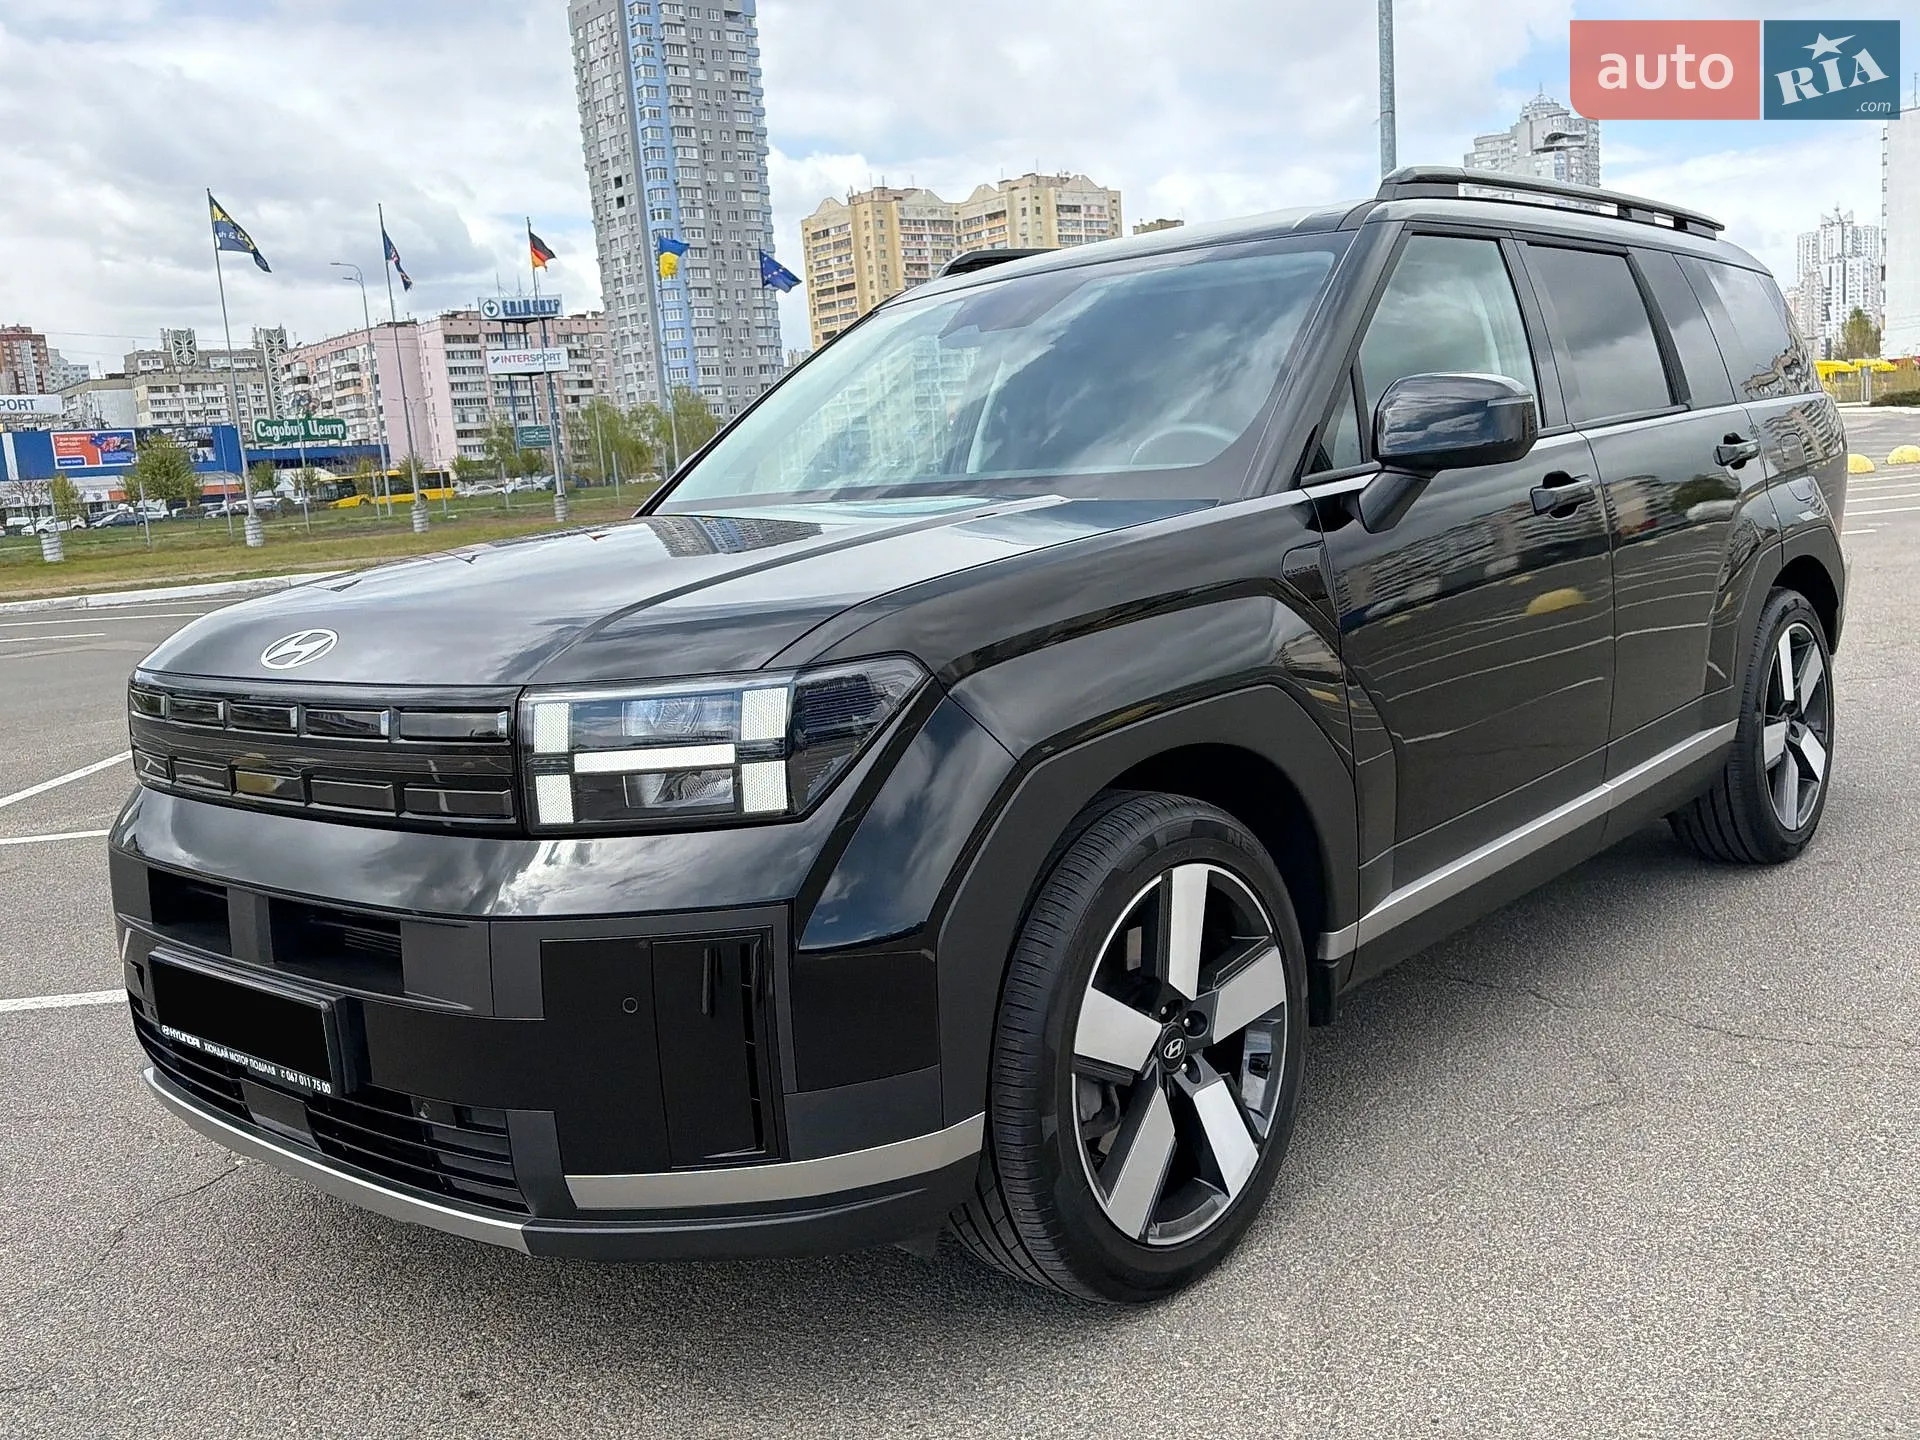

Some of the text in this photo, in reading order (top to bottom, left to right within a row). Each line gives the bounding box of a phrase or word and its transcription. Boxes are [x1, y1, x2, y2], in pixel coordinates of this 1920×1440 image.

[501, 352, 561, 364] INTERSPORT
[256, 420, 345, 442] Садовий Центр
[229, 1051, 249, 1067] МОТОР
[286, 1071, 298, 1083] 067
[299, 1075, 311, 1088] 011
[312, 1078, 321, 1091] 75
[321, 1082, 331, 1095] 00
